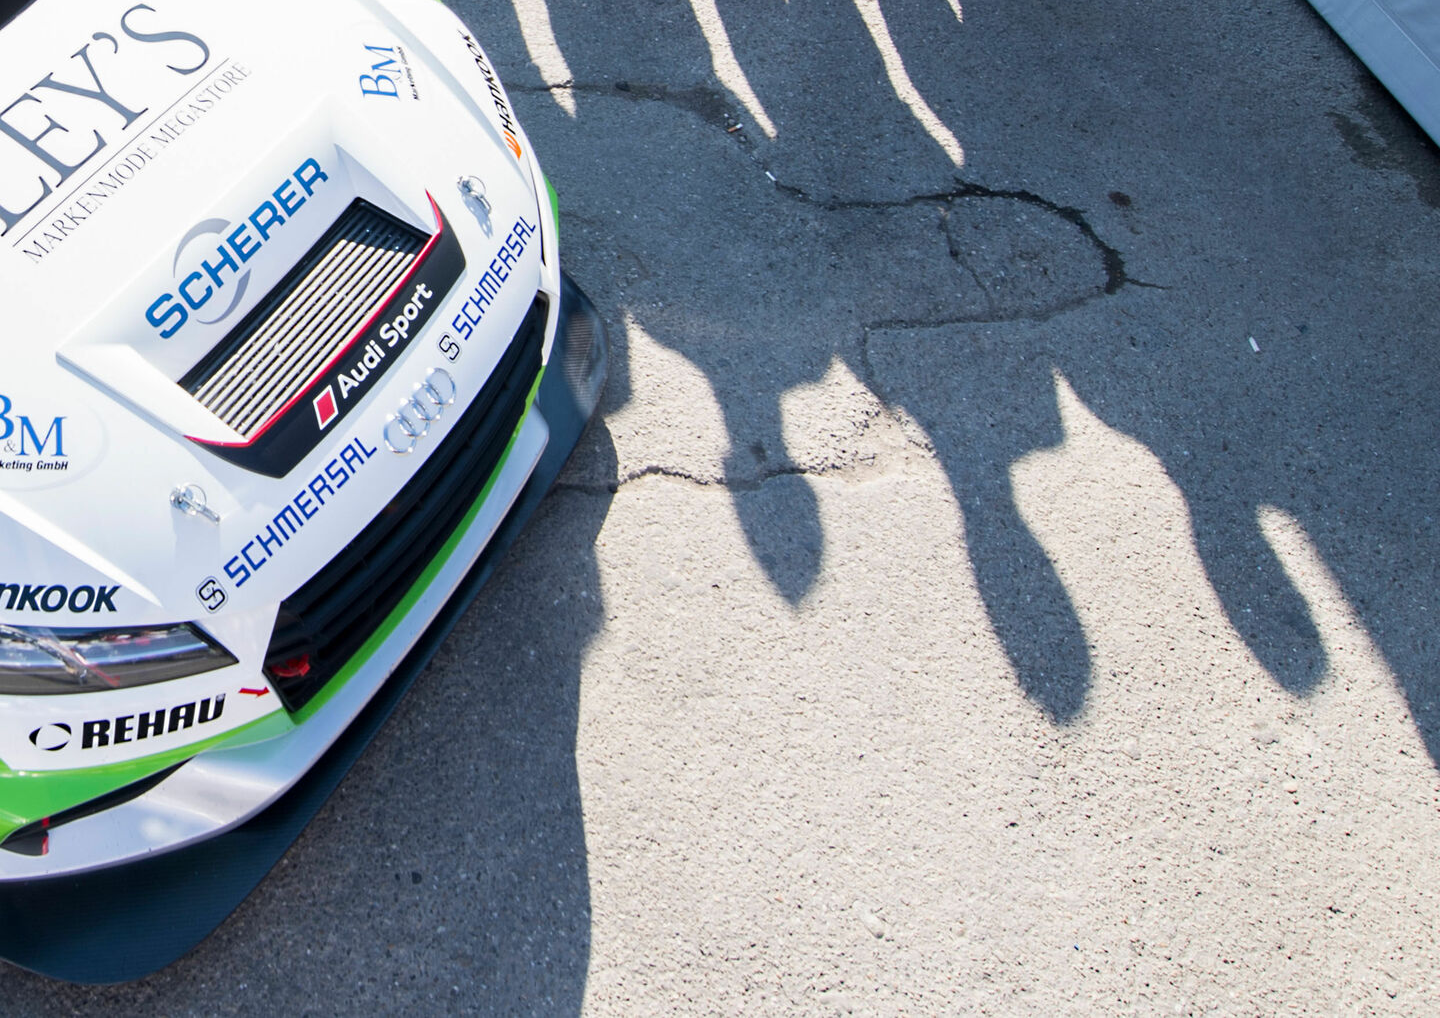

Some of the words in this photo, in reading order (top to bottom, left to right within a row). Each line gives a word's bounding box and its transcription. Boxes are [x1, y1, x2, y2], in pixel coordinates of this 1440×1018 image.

[22, 142, 158, 264] MARKENMODE
[151, 62, 253, 152] MEGASTORE
[145, 157, 329, 339] SCHERER
[452, 216, 537, 341] SCHMERSAL
[337, 342, 386, 399] Audi
[384, 283, 434, 348] Sport
[36, 460, 69, 471] GmbH
[223, 437, 377, 588] SCHMERSAL
[81, 693, 226, 750] REHAU
